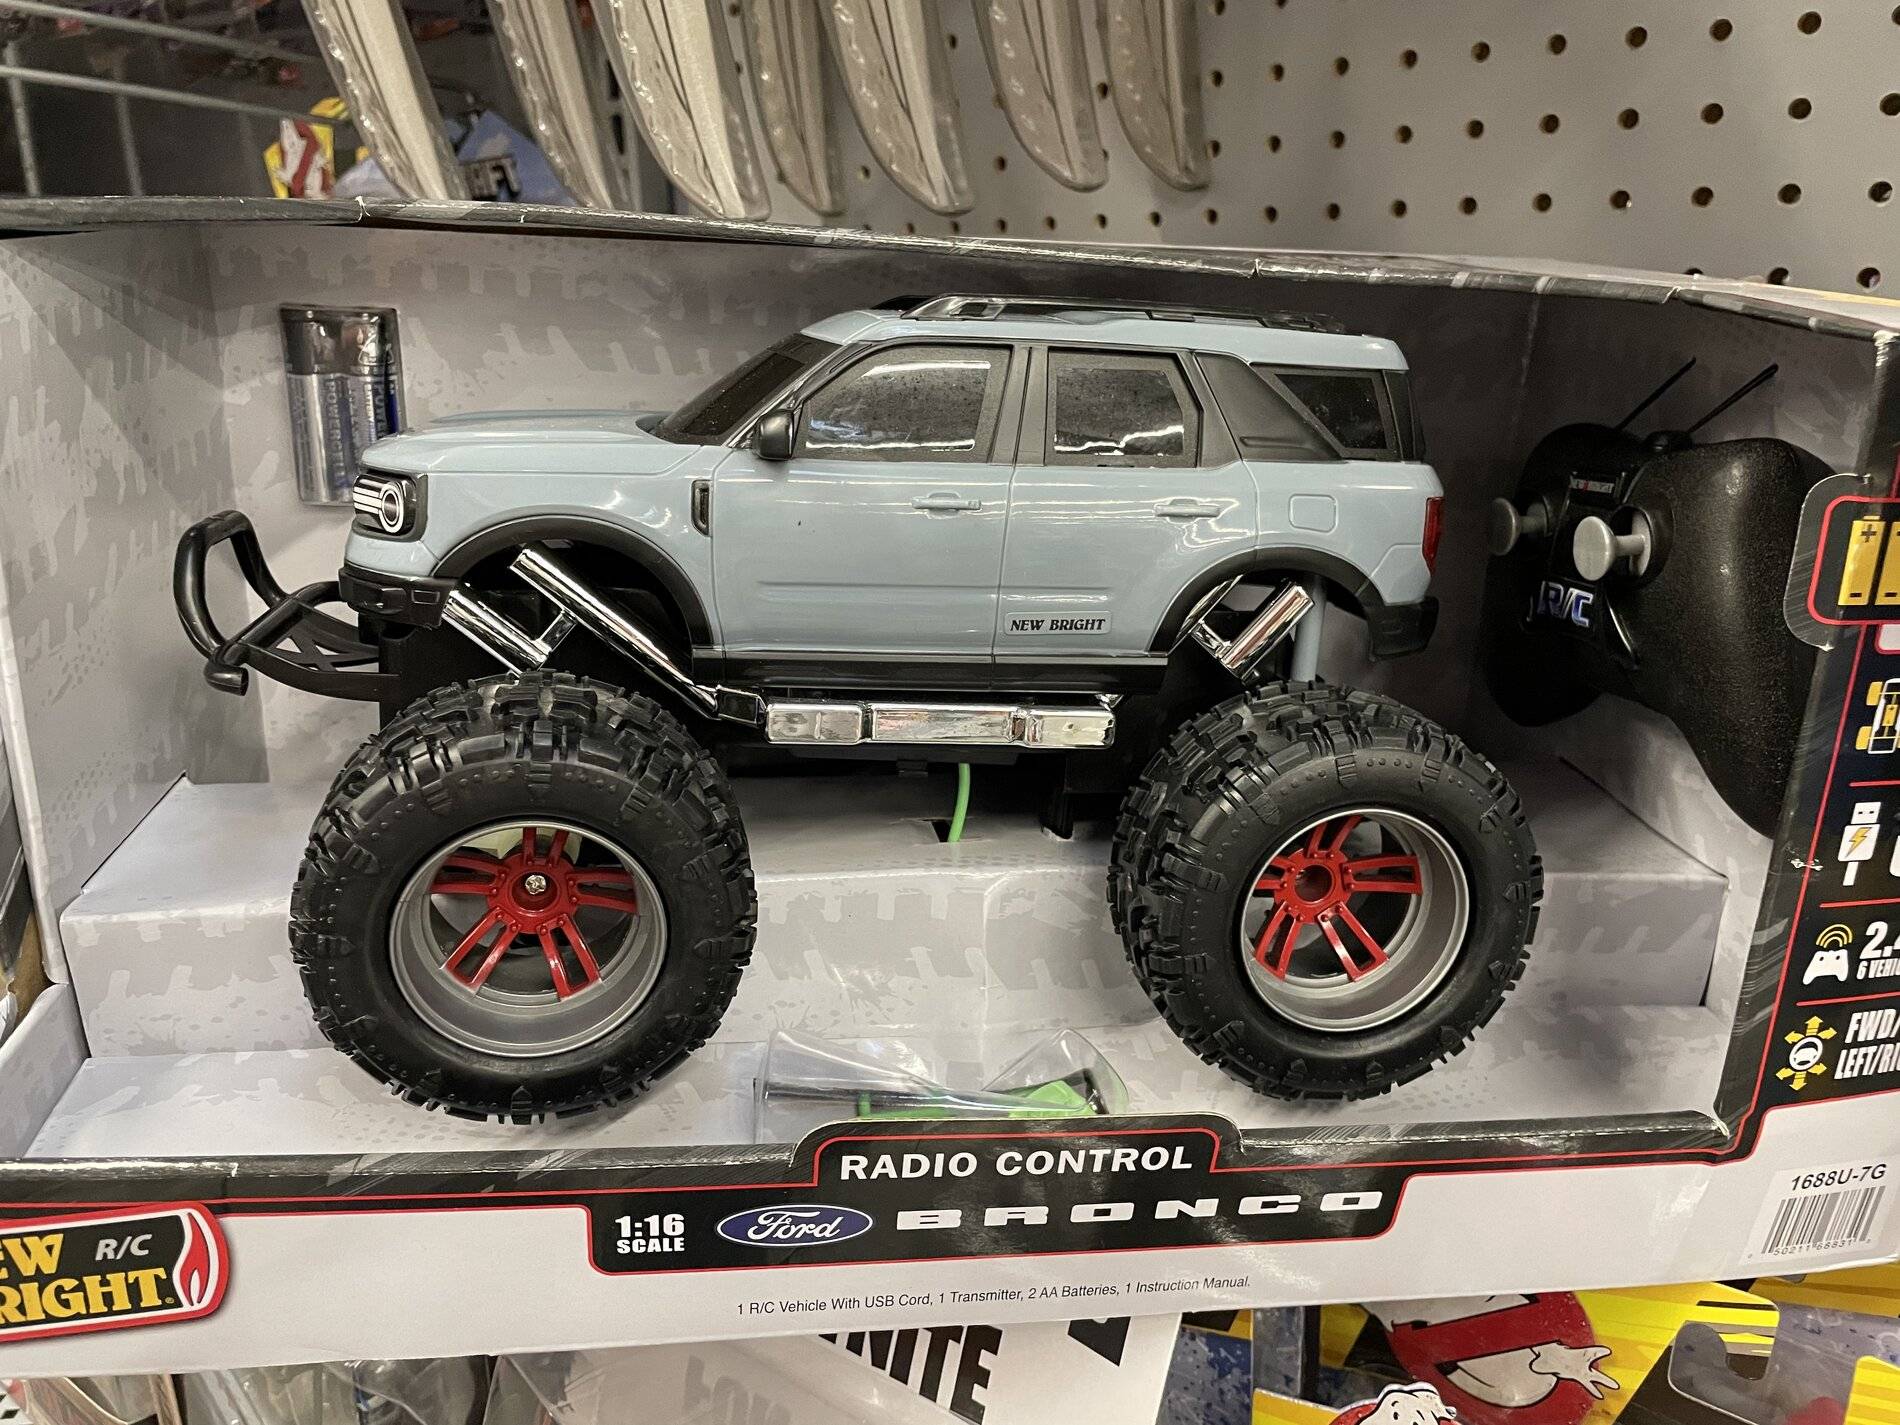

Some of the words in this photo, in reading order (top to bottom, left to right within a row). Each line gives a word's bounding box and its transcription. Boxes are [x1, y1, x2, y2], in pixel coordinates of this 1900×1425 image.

[1010, 619, 1045, 631] NEW
[1049, 618, 1106, 631] BRIGHT
[1856, 960, 1868, 980] 6
[840, 1152, 978, 1181] RADIO
[995, 1145, 1193, 1176] CONTROL
[1791, 1163, 1887, 1191] 1688U-7G
[896, 1191, 1383, 1231] BRONCO
[615, 1213, 685, 1239] 1:16
[747, 1210, 845, 1240] Ford
[95, 1234, 152, 1261] R/C
[616, 1238, 685, 1254] SCALE
[737, 1303, 744, 1315] 1
[749, 1301, 775, 1314] R/C
[780, 1299, 827, 1313] Vehicle
[832, 1297, 860, 1310] With
[865, 1294, 894, 1308] USB
[899, 1292, 933, 1307] Cord,
[939, 1292, 945, 1304] 1
[950, 1288, 1024, 1303] Transmitter,
[1028, 1288, 1037, 1300] 2
[1039, 1286, 1058, 1299] AA
[1061, 1284, 1120, 1298] Batteries,
[1125, 1283, 1131, 1294] 1
[1136, 1279, 1199, 1294] Instruction
[1203, 1276, 1250, 1289] Manual.
